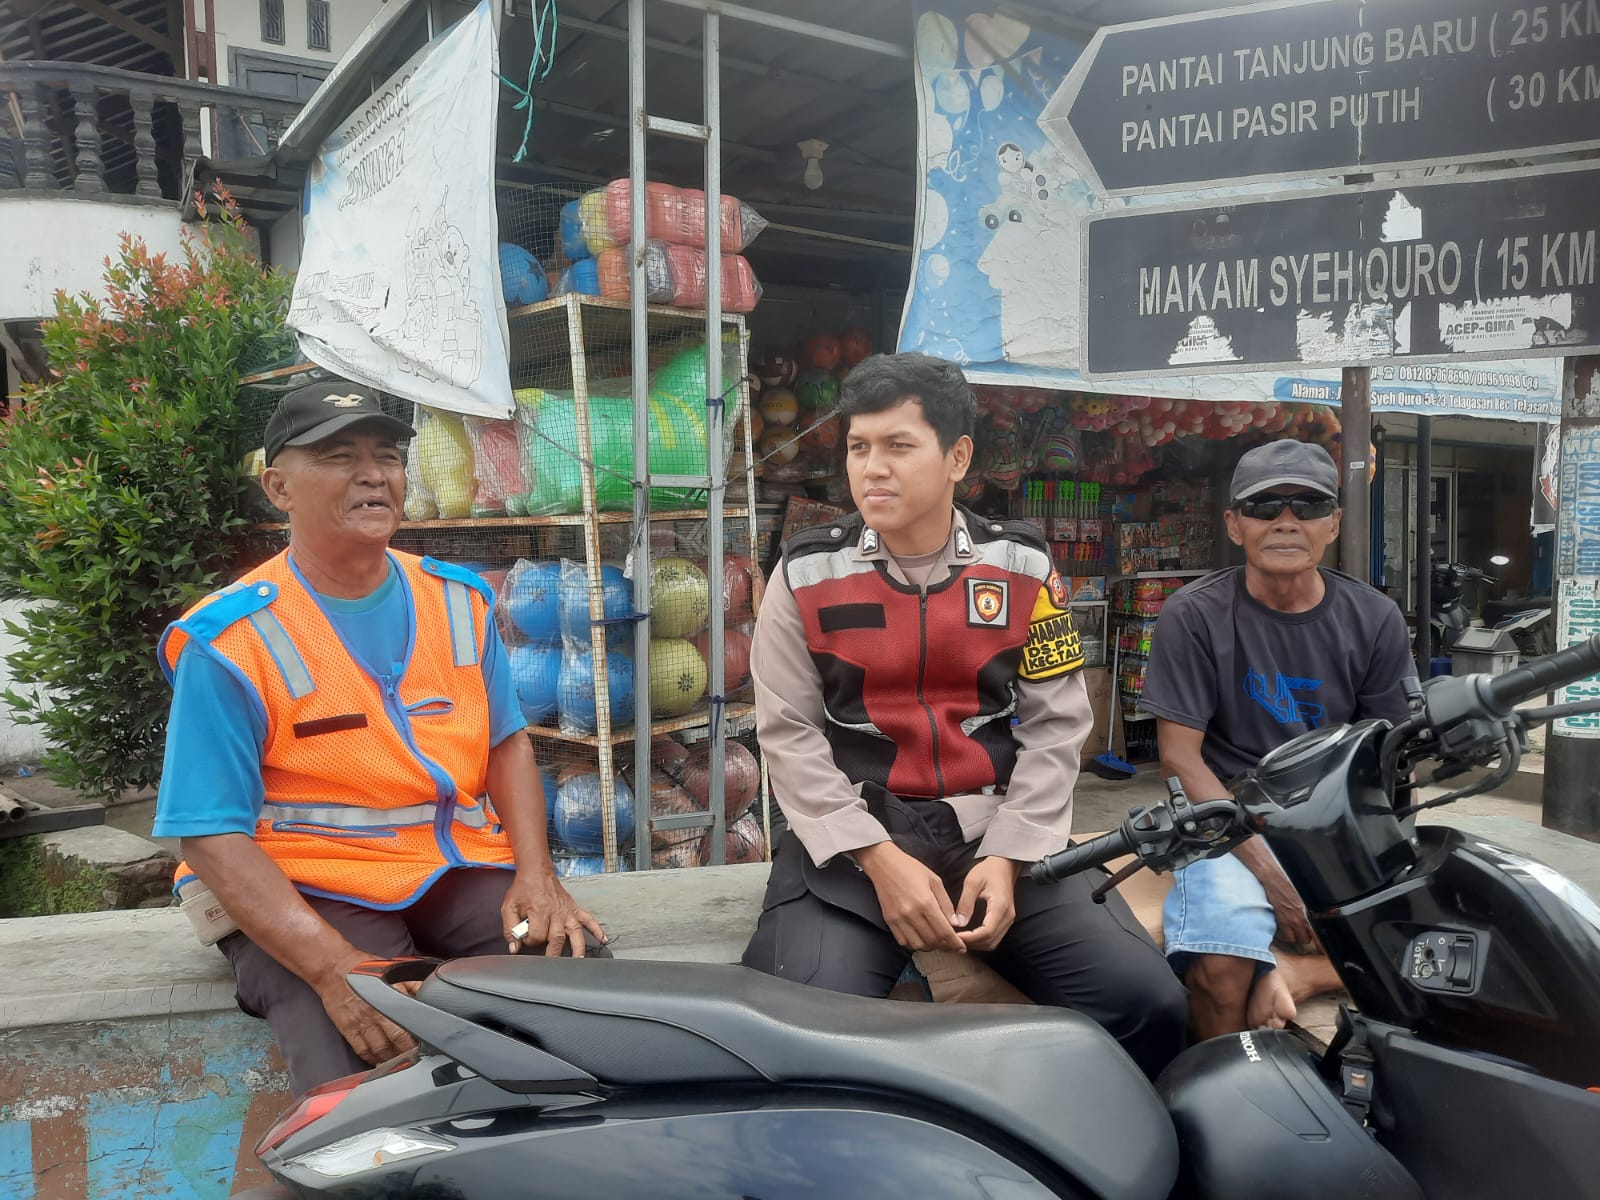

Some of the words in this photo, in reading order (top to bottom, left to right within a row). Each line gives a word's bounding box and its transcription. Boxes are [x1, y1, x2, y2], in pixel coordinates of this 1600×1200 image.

[1122, 52, 1223, 97] PANTAI
[1233, 32, 1375, 82] TANJUNG
[1385, 16, 1477, 62] BARU
[1510, 6, 1549, 46] 25
[1121, 111, 1222, 153] PANTAI
[1232, 98, 1319, 140] PASIR
[1330, 86, 1420, 129] PUTIH
[1508, 71, 1546, 110] 30
[1557, 64, 1600, 104] KM
[1138, 257, 1259, 316] MAKAM
[1270, 246, 1353, 307] SYEH
[1365, 240, 1462, 303] QURO
[1496, 234, 1529, 292] 15
[1541, 229, 1596, 288] KM
[1446, 320, 1515, 336] ACEP-GINA
[1291, 382, 1329, 400] Alamat
[1371, 391, 1396, 407] Syeh
[1398, 392, 1422, 407] Quro
[1399, 366, 1423, 381] 0812
